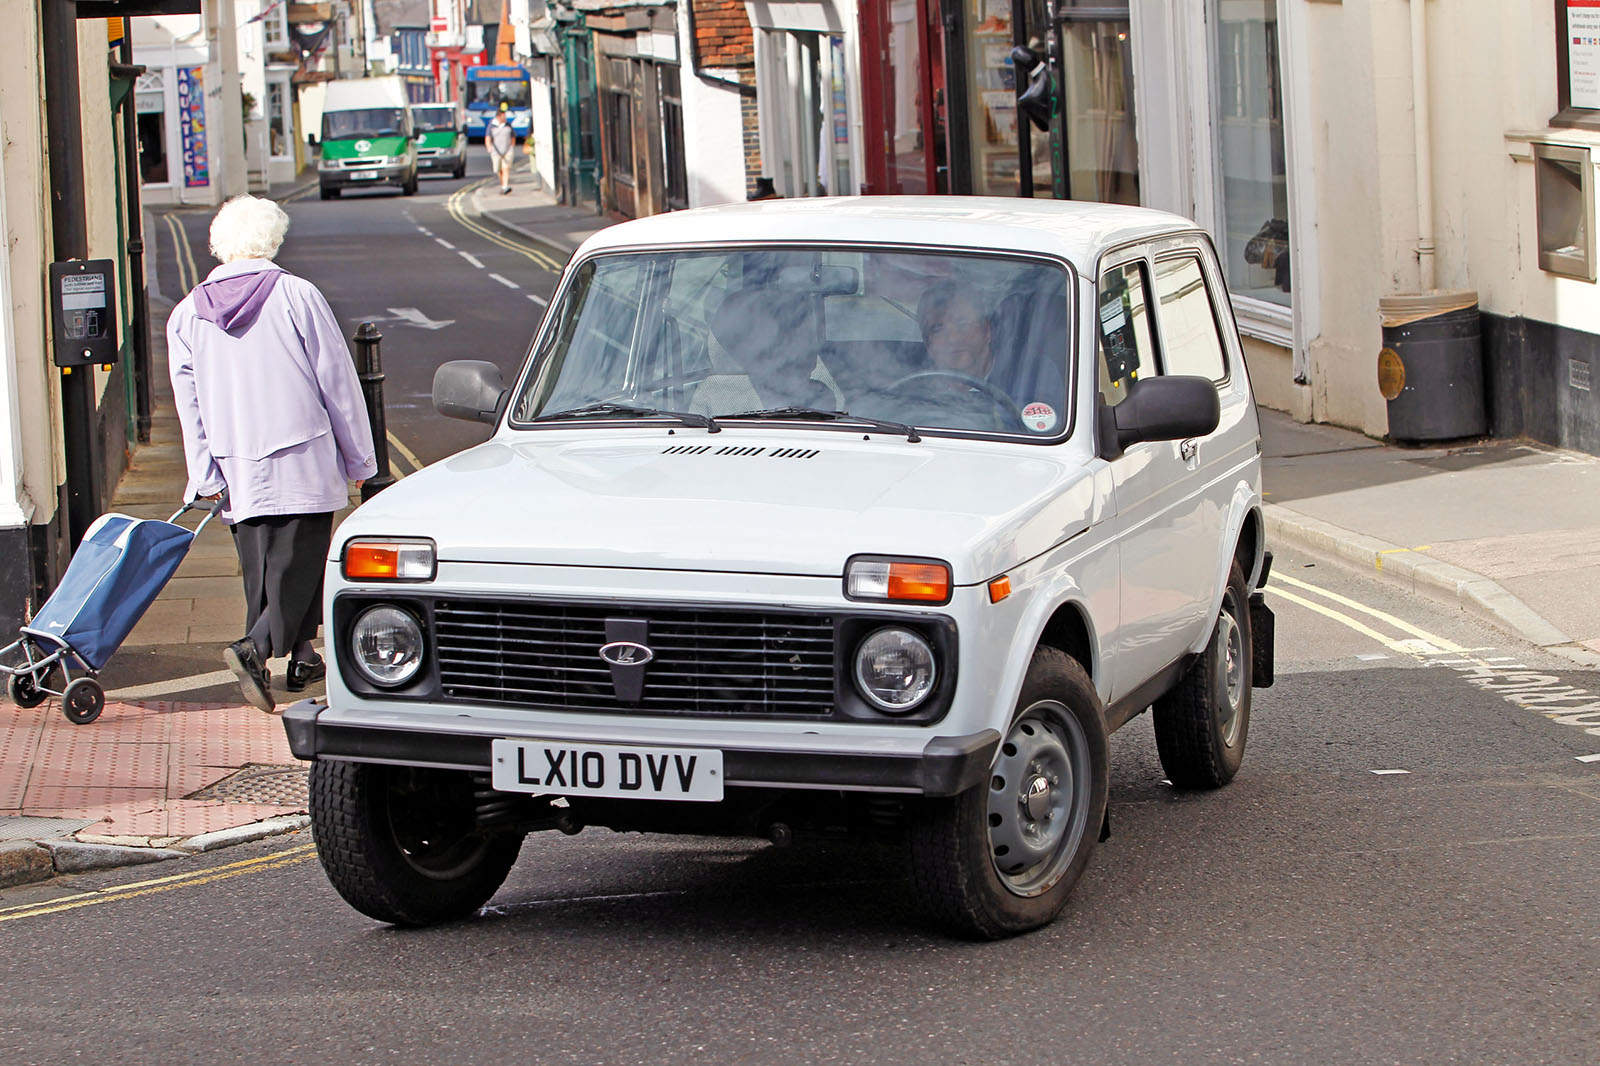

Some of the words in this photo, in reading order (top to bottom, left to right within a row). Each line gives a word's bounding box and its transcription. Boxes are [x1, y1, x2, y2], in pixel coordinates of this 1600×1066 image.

[178, 69, 195, 177] AQUATICS
[517, 746, 605, 789] LX10
[618, 752, 698, 793] DVV
